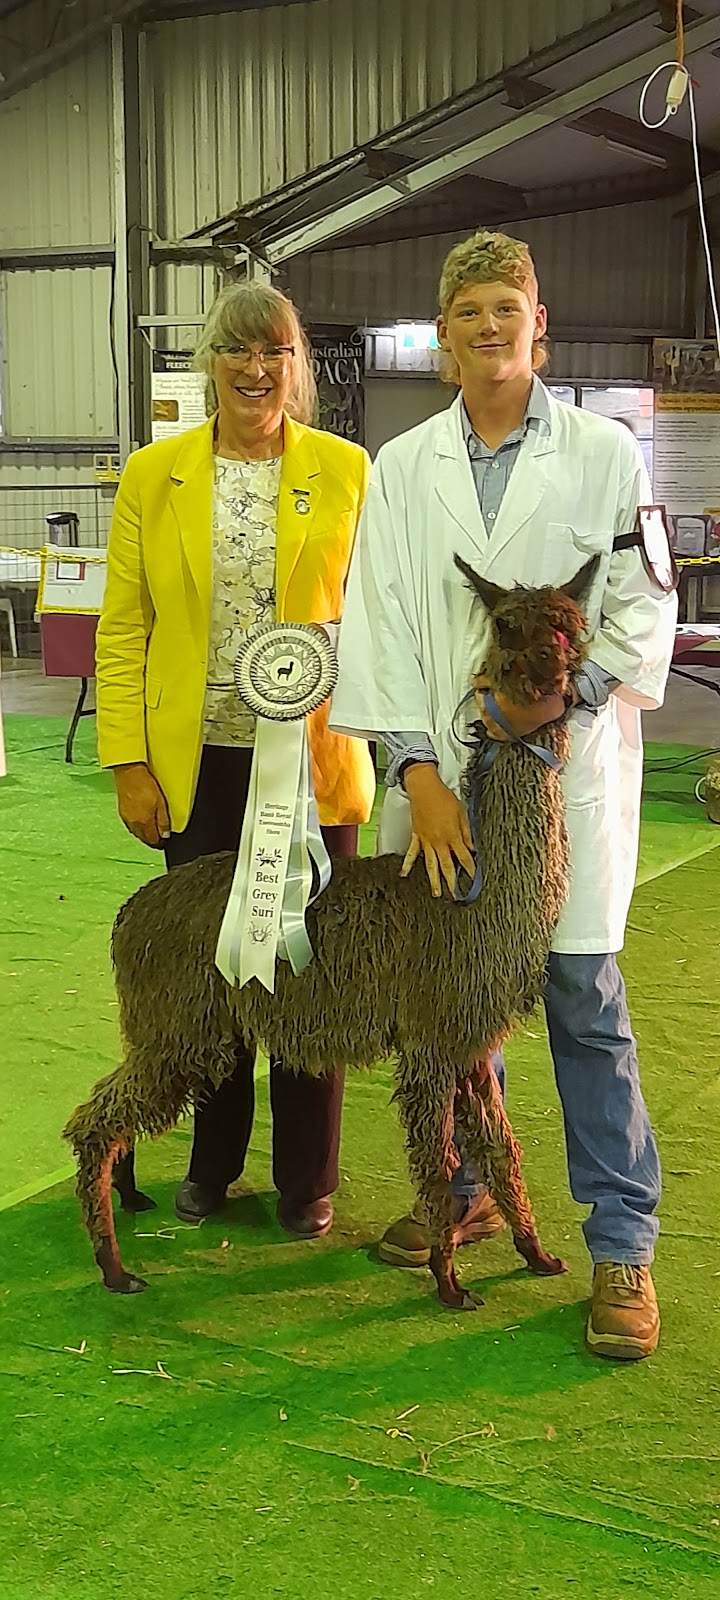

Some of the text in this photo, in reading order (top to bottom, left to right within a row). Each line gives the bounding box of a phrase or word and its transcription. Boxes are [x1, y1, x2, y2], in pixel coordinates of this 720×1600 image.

[310, 342, 363, 358] ustralian
[256, 872, 279, 883] Best
[253, 889, 278, 903] Grey
[252, 906, 274, 918] Suri
